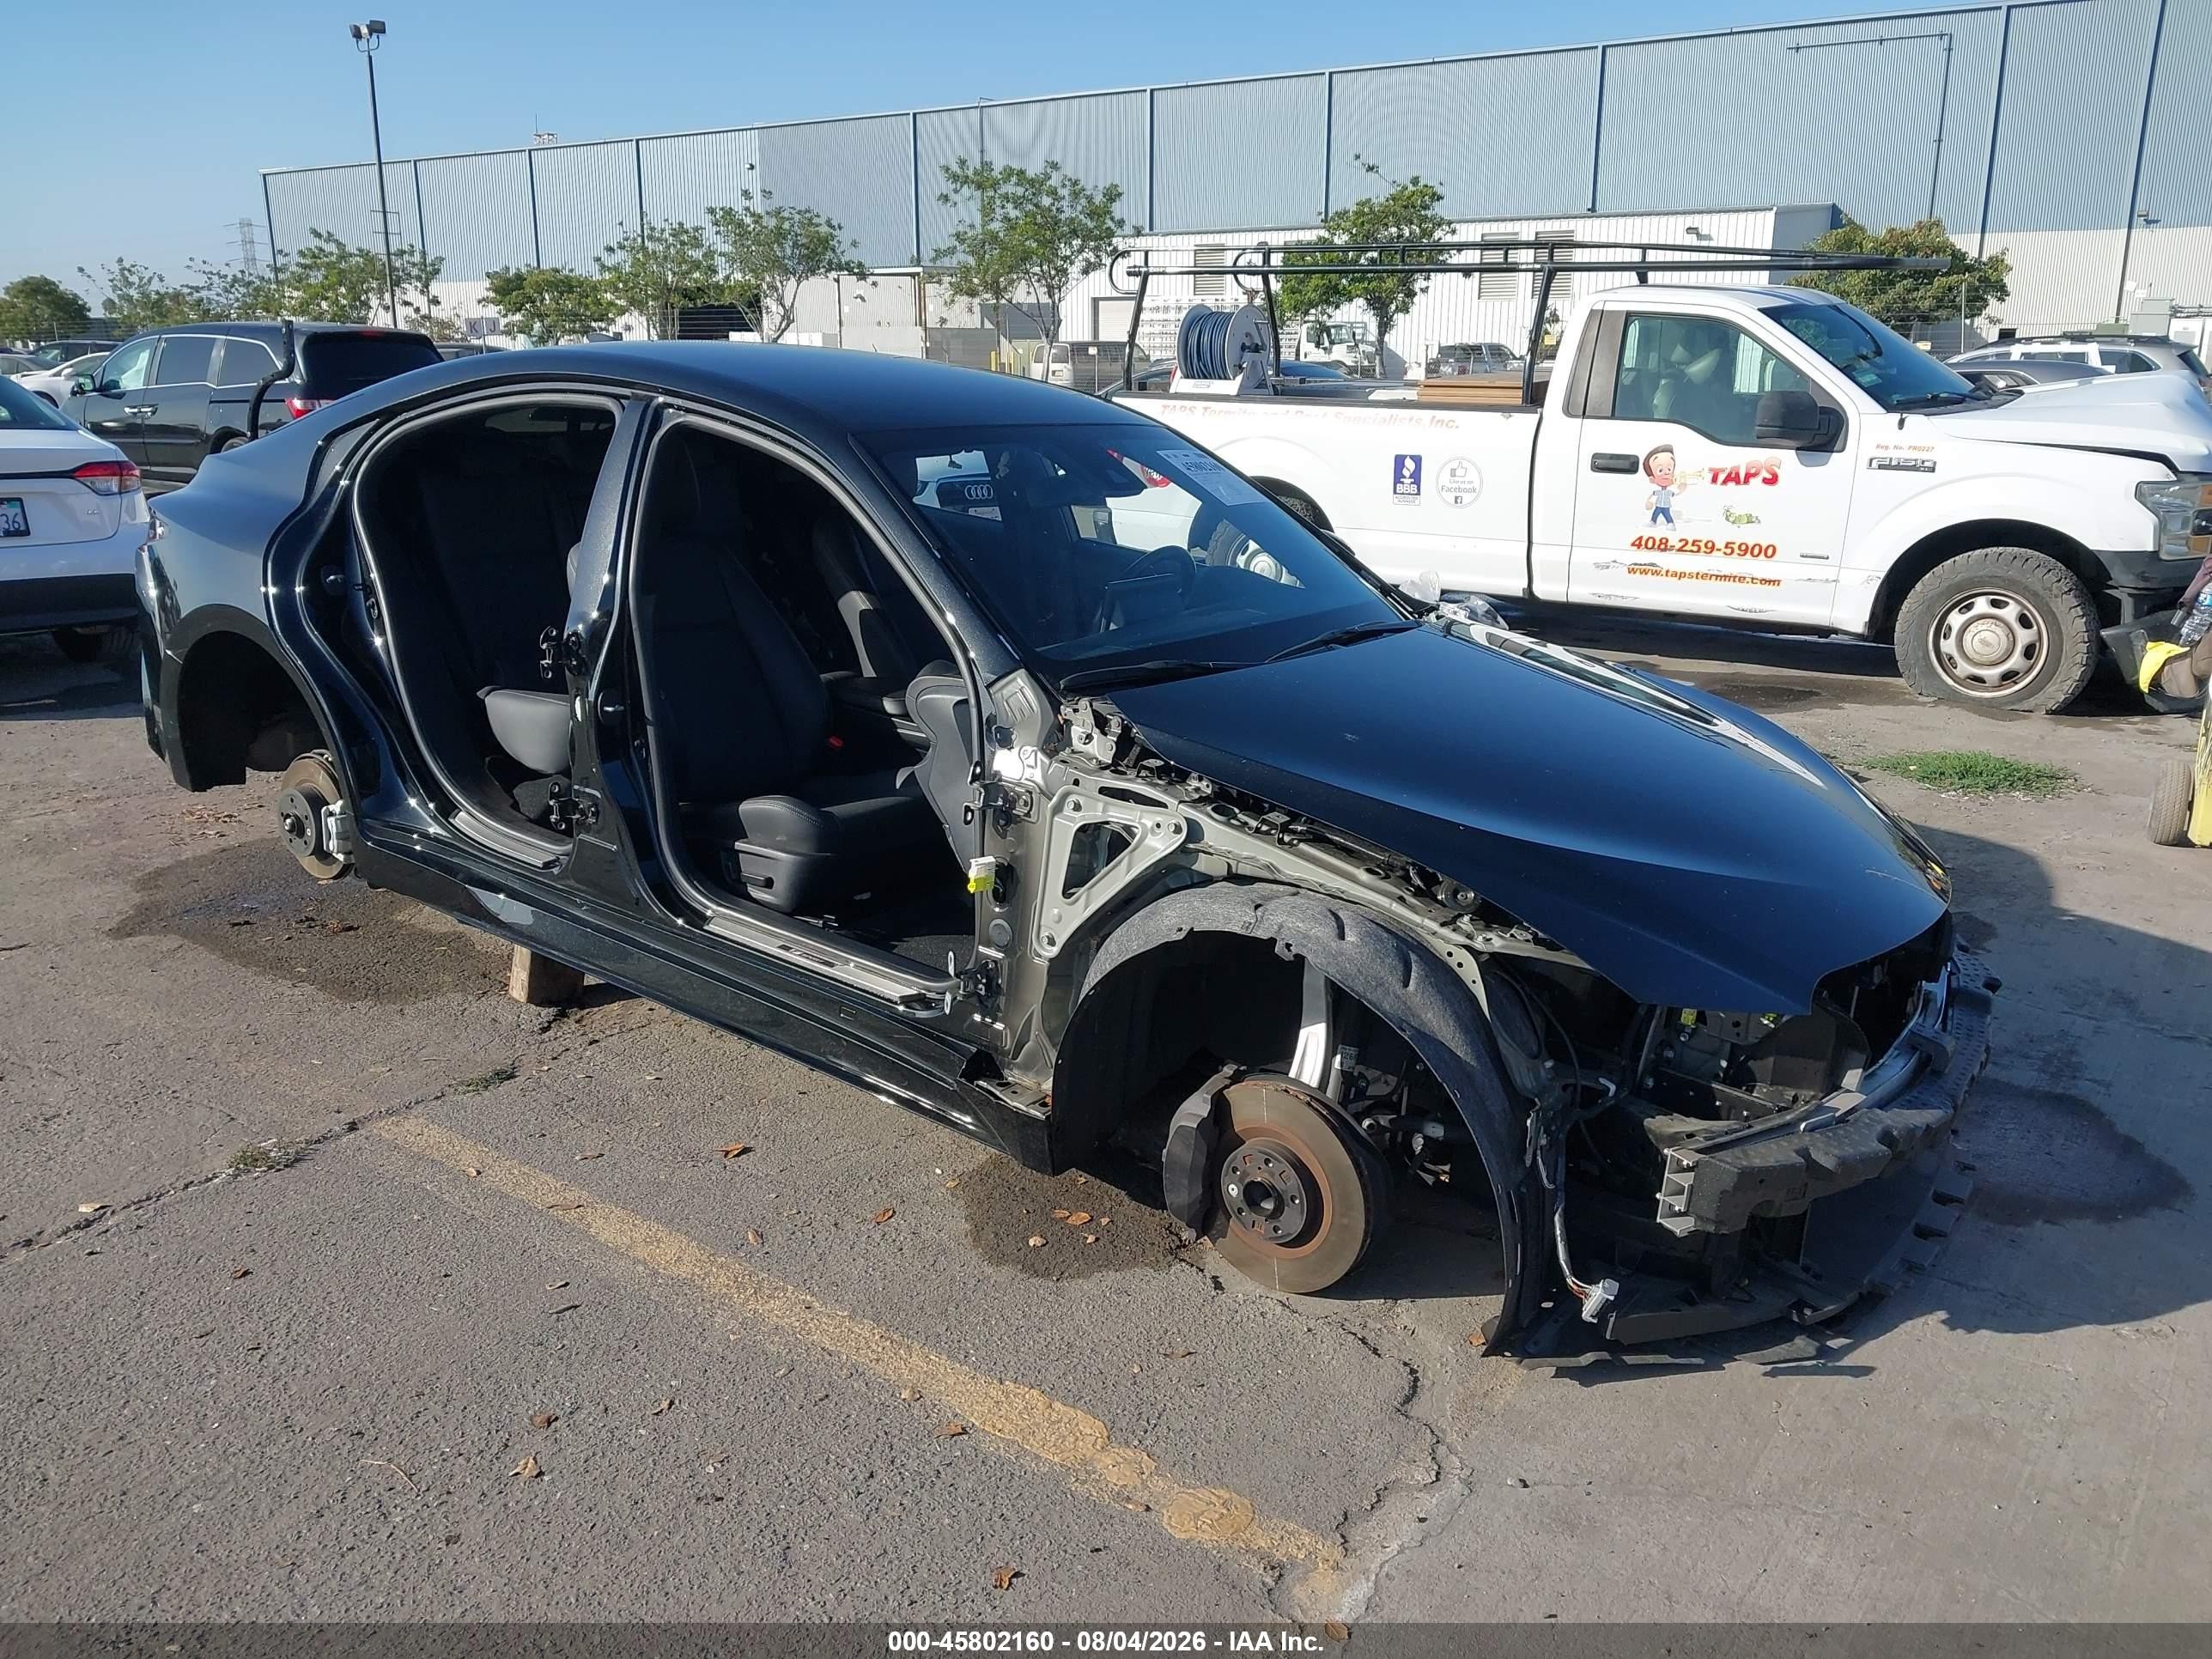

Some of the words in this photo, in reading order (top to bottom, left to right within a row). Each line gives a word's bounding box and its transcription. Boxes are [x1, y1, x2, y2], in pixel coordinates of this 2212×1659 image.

[468, 320, 478, 334] K
[489, 319, 496, 333] J
[1708, 457, 1783, 487] TAPS
[1395, 483, 1418, 494] BBB
[1441, 484, 1477, 494] Facebook
[1630, 535, 1778, 560] 408-259-5900
[1627, 565, 1783, 586] www.tapstermite.com
